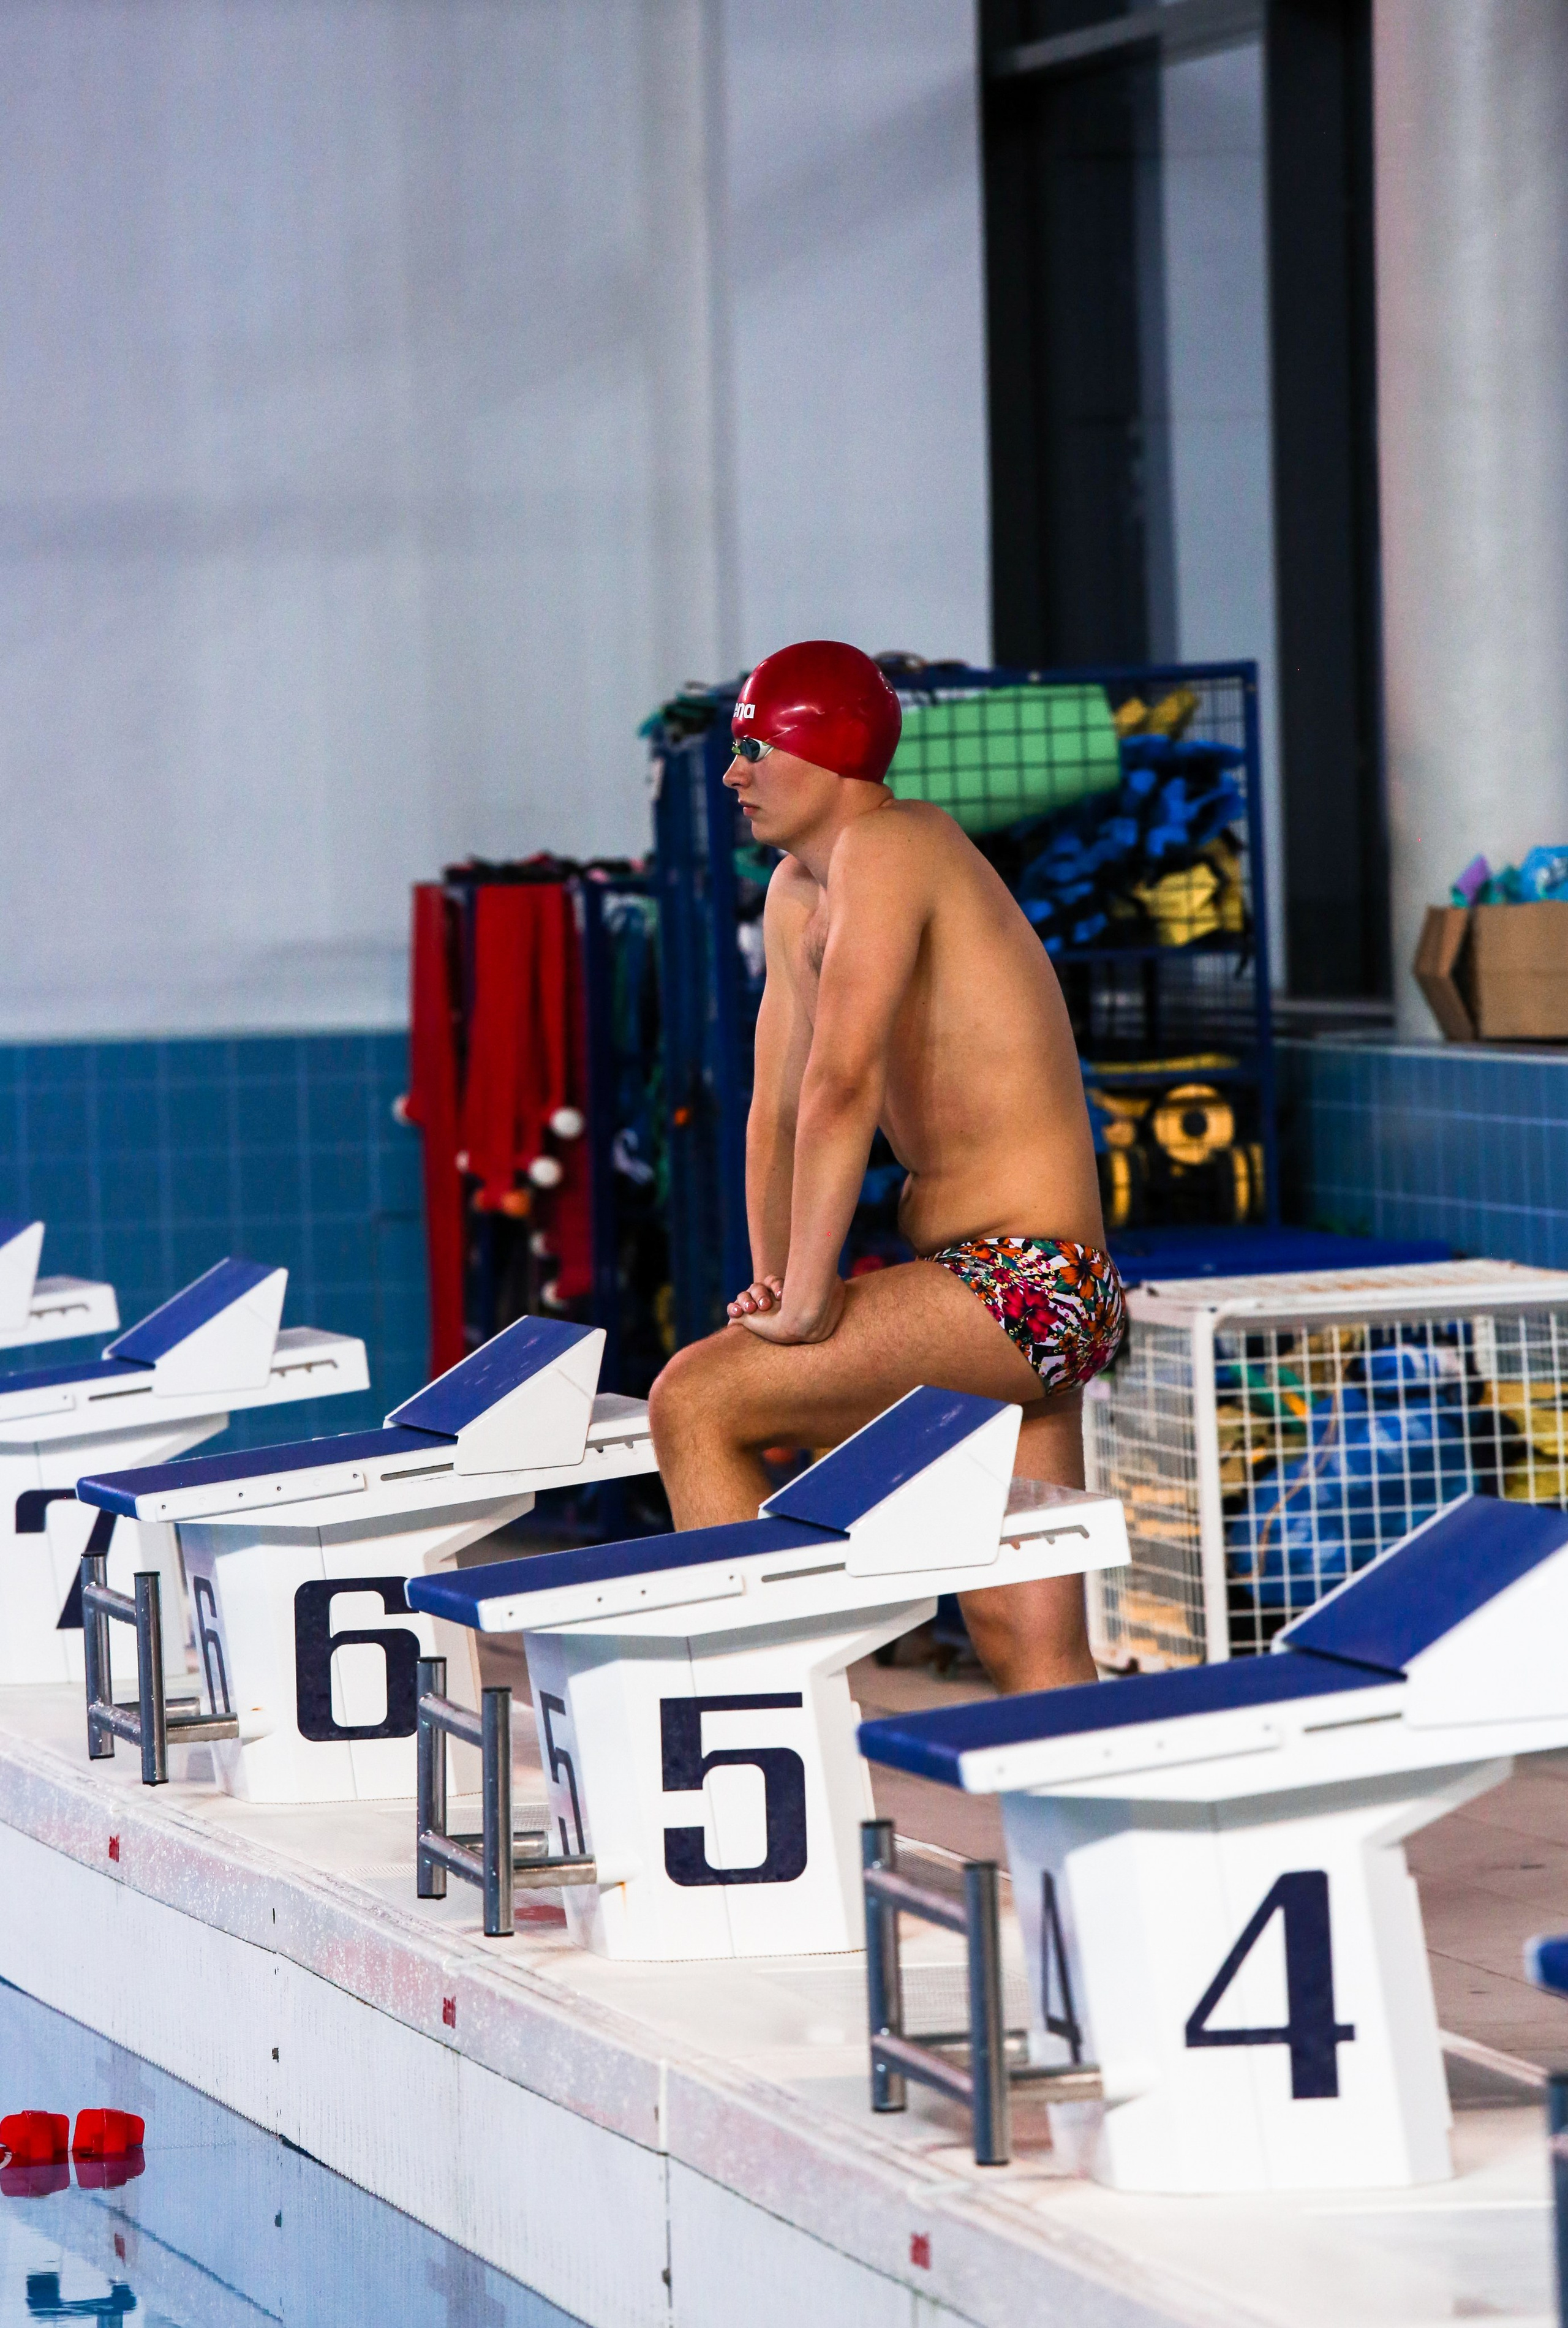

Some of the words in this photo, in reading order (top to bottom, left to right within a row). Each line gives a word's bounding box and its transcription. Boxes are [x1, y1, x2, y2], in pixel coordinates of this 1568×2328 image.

[16, 1488, 118, 1629] 7
[295, 1576, 421, 1742] 6
[540, 1690, 586, 1855] 5
[660, 1692, 807, 1886] 5
[1043, 1869, 1081, 2064] 4
[1184, 1869, 1355, 2100] 4
